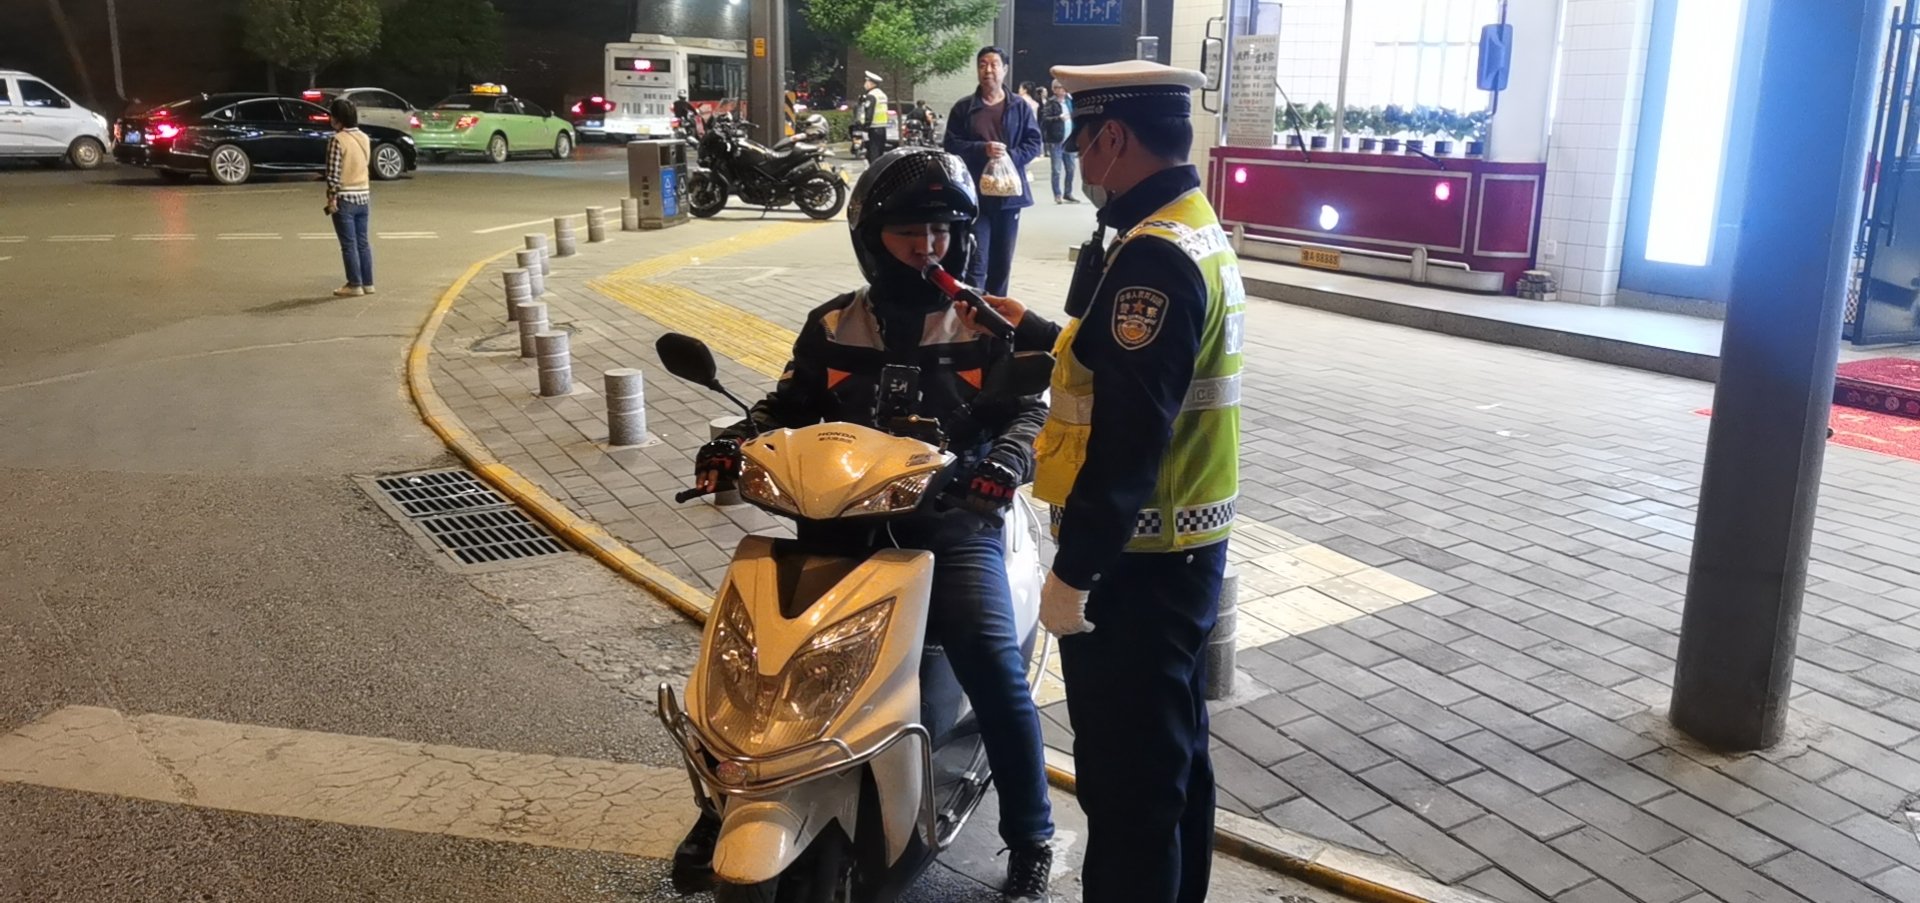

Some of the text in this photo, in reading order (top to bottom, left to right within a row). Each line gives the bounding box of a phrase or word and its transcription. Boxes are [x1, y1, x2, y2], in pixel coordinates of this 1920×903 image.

[1147, 306, 1158, 319] 察
[1190, 388, 1216, 401] ICE
[817, 431, 857, 440] HONDA
